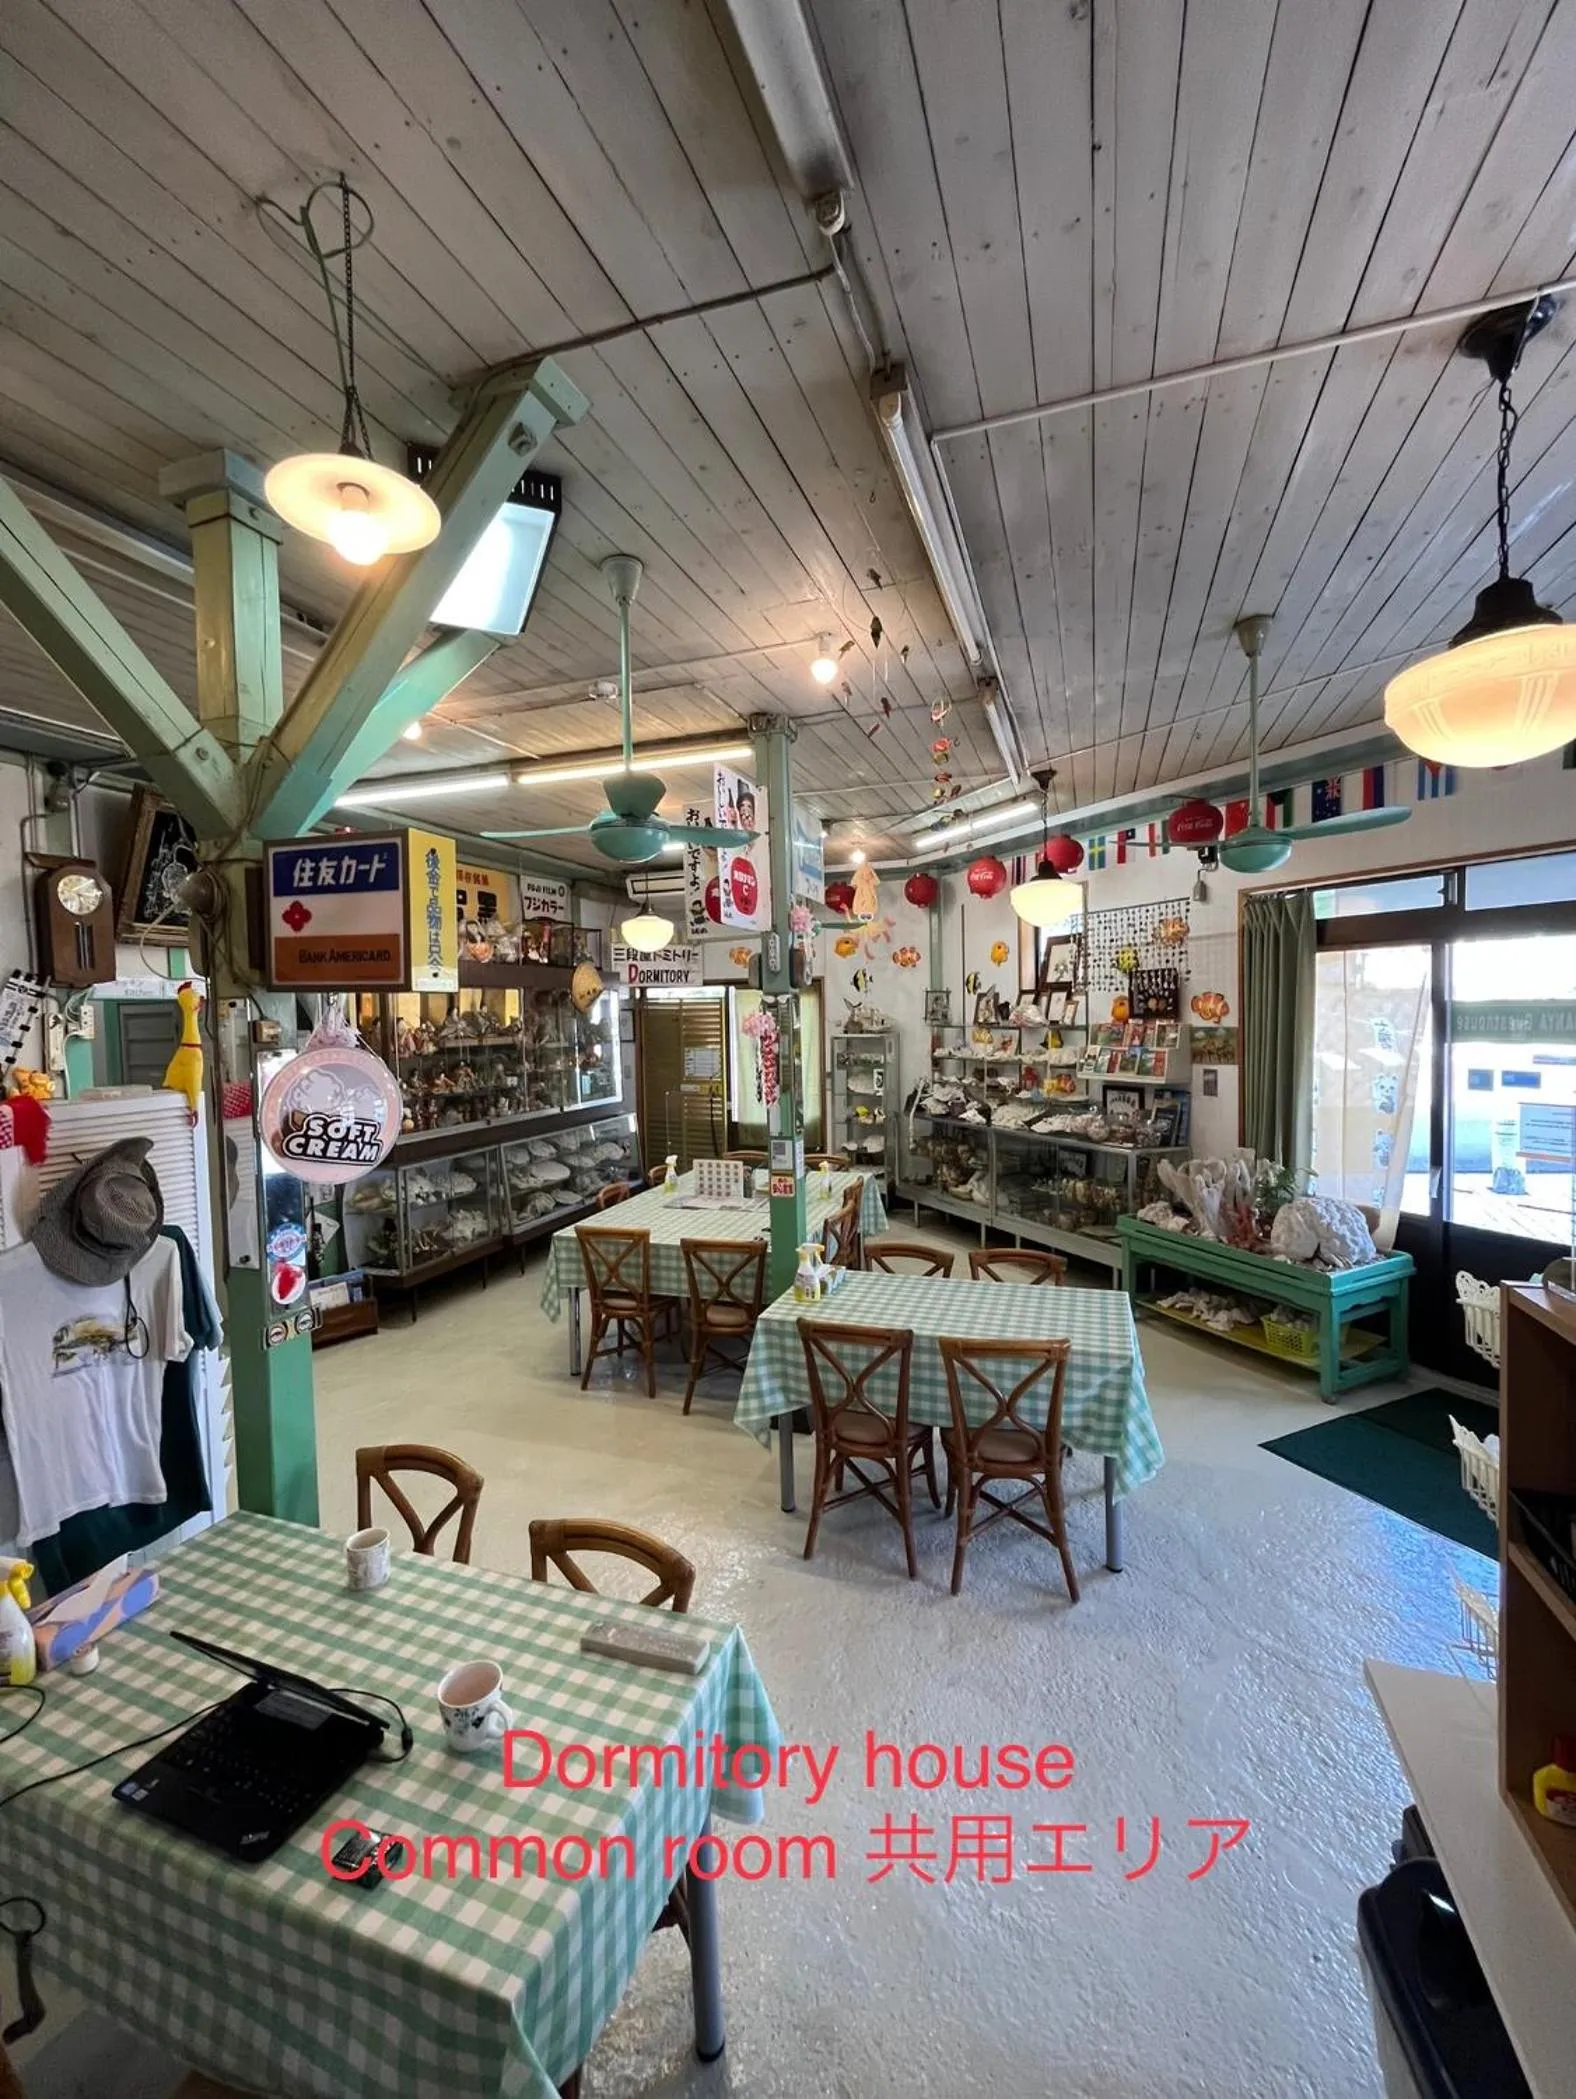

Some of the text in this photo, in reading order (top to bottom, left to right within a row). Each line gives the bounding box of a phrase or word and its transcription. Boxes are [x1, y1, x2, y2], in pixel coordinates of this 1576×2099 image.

[292, 853, 387, 888] 住友カード
[524, 896, 565, 914] フジカラー
[628, 963, 690, 984] DORMITORY
[307, 1118, 376, 1143] SOFT
[288, 1136, 380, 1161] CREAM
